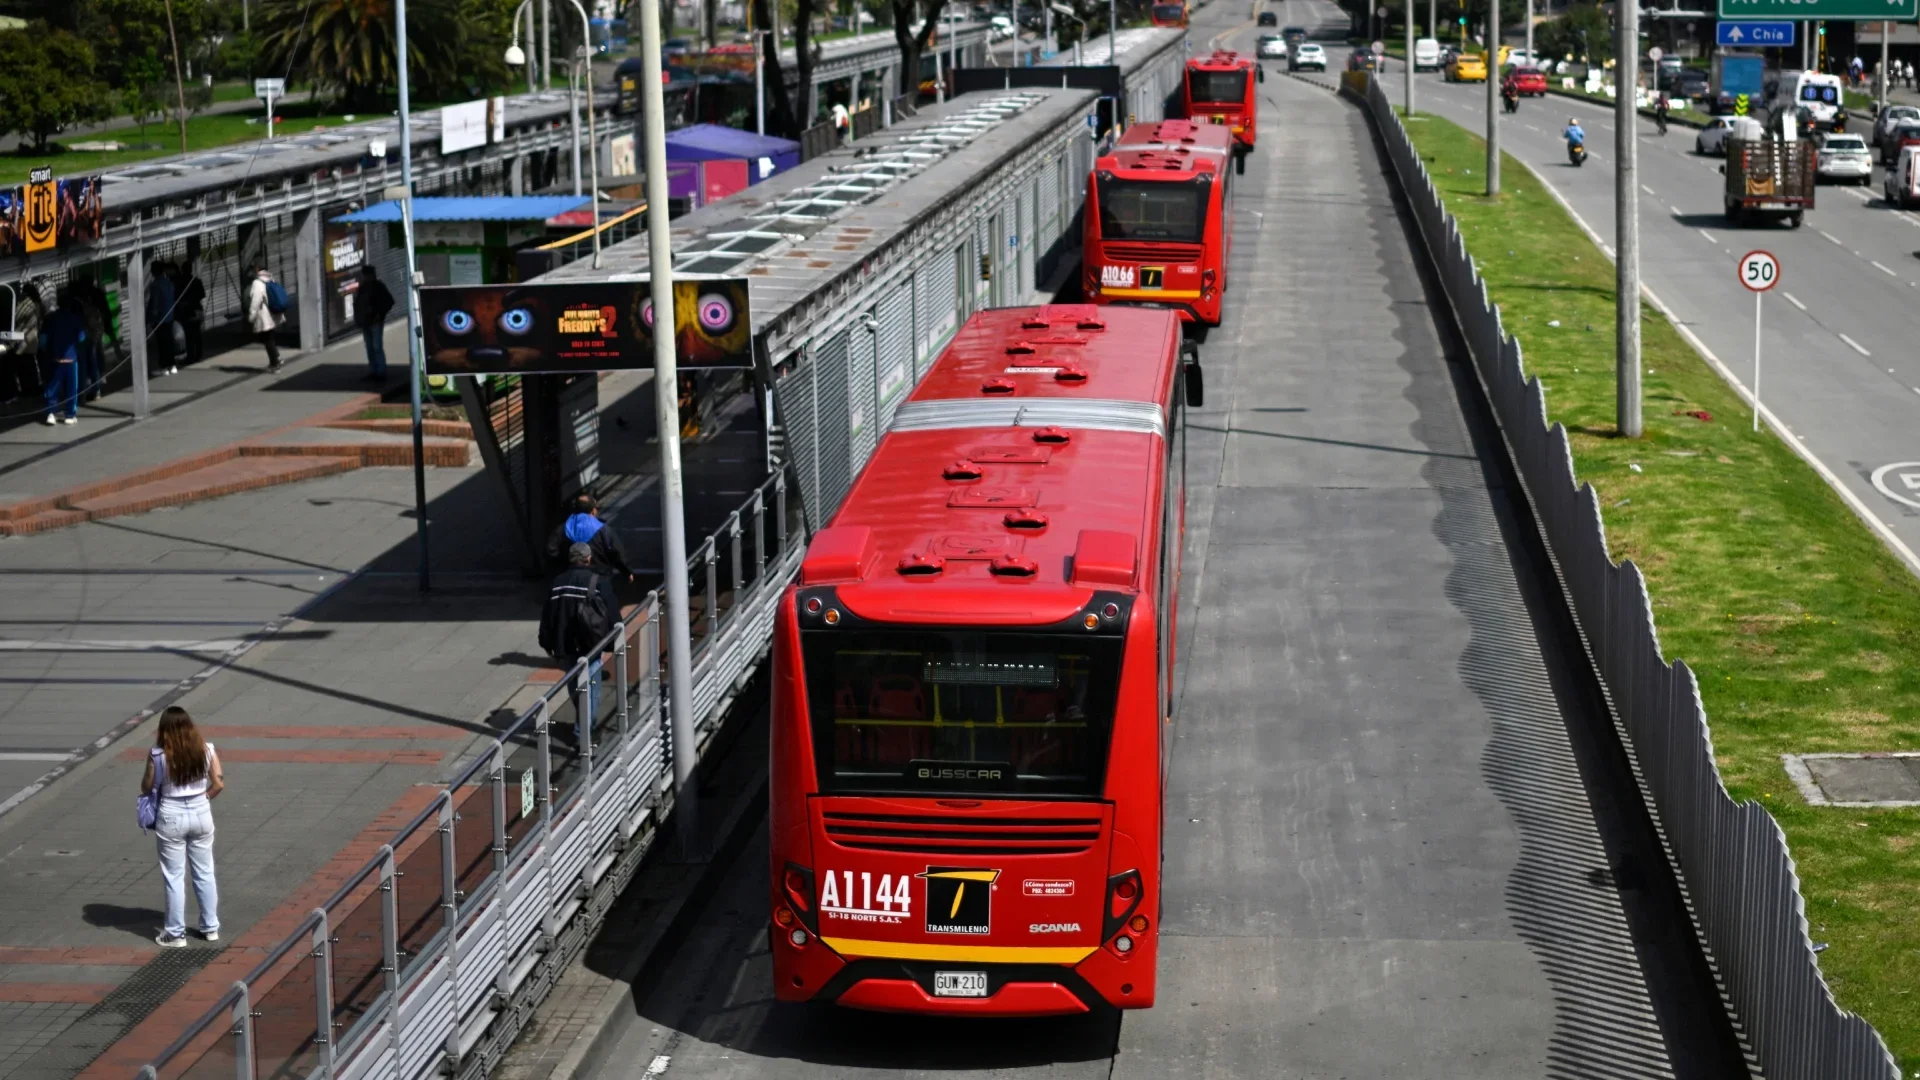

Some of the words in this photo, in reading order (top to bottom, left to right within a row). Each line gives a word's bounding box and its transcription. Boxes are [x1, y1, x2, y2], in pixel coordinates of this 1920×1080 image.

[1752, 27, 1784, 41] Chía
[31, 168, 51, 183] smart
[1747, 261, 1773, 281] 50
[558, 317, 607, 334] FREDDY'S
[600, 305, 618, 338] 2
[918, 768, 1001, 779] BUSSCAR
[820, 869, 911, 912] A1144
[828, 912, 849, 920] SI-18
[851, 914, 878, 922] NORTE
[879, 916, 902, 924] S.A.S.
[928, 924, 989, 933] TRANSMILENIO
[1029, 922, 1081, 933] SCANIA
